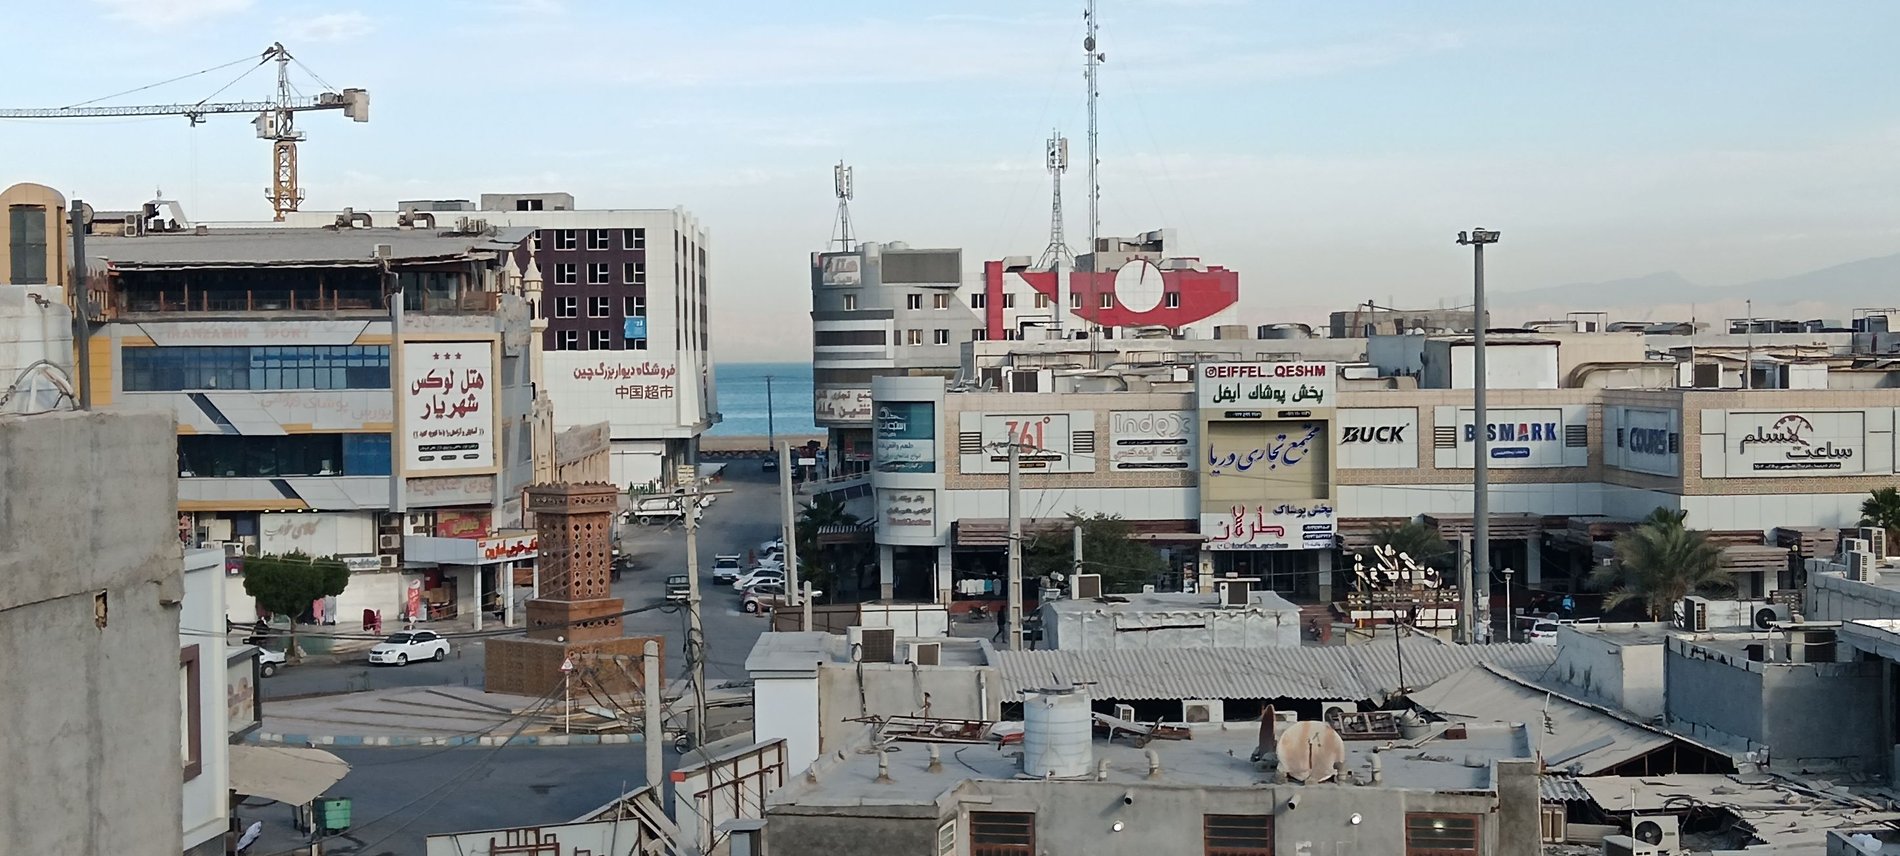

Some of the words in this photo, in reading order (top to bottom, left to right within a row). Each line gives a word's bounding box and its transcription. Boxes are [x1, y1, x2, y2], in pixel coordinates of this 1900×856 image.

[573, 367, 595, 381] چین
[595, 362, 615, 380] بزرگ
[637, 362, 676, 380] فروشگاه
[1218, 365, 1326, 378] EIFFEL_QESHM
[411, 368, 454, 396] لوکس
[460, 369, 485, 395] هتل
[615, 384, 674, 400] 中国超市
[1213, 383, 1241, 404] ایفل
[1292, 384, 1324, 405] پخش
[420, 392, 479, 421] شهریار
[1338, 422, 1410, 445] BUCK
[1463, 422, 1557, 443] BSMARK
[1160, 447, 1191, 460] عینک
[1236, 433, 1287, 472] تجاری
[1283, 423, 1321, 464] مجتمع
[1785, 441, 1853, 460] ساعت
[1208, 442, 1236, 477] دریا
[1273, 504, 1306, 519] پوشاک
[1307, 503, 1333, 519] پخش
